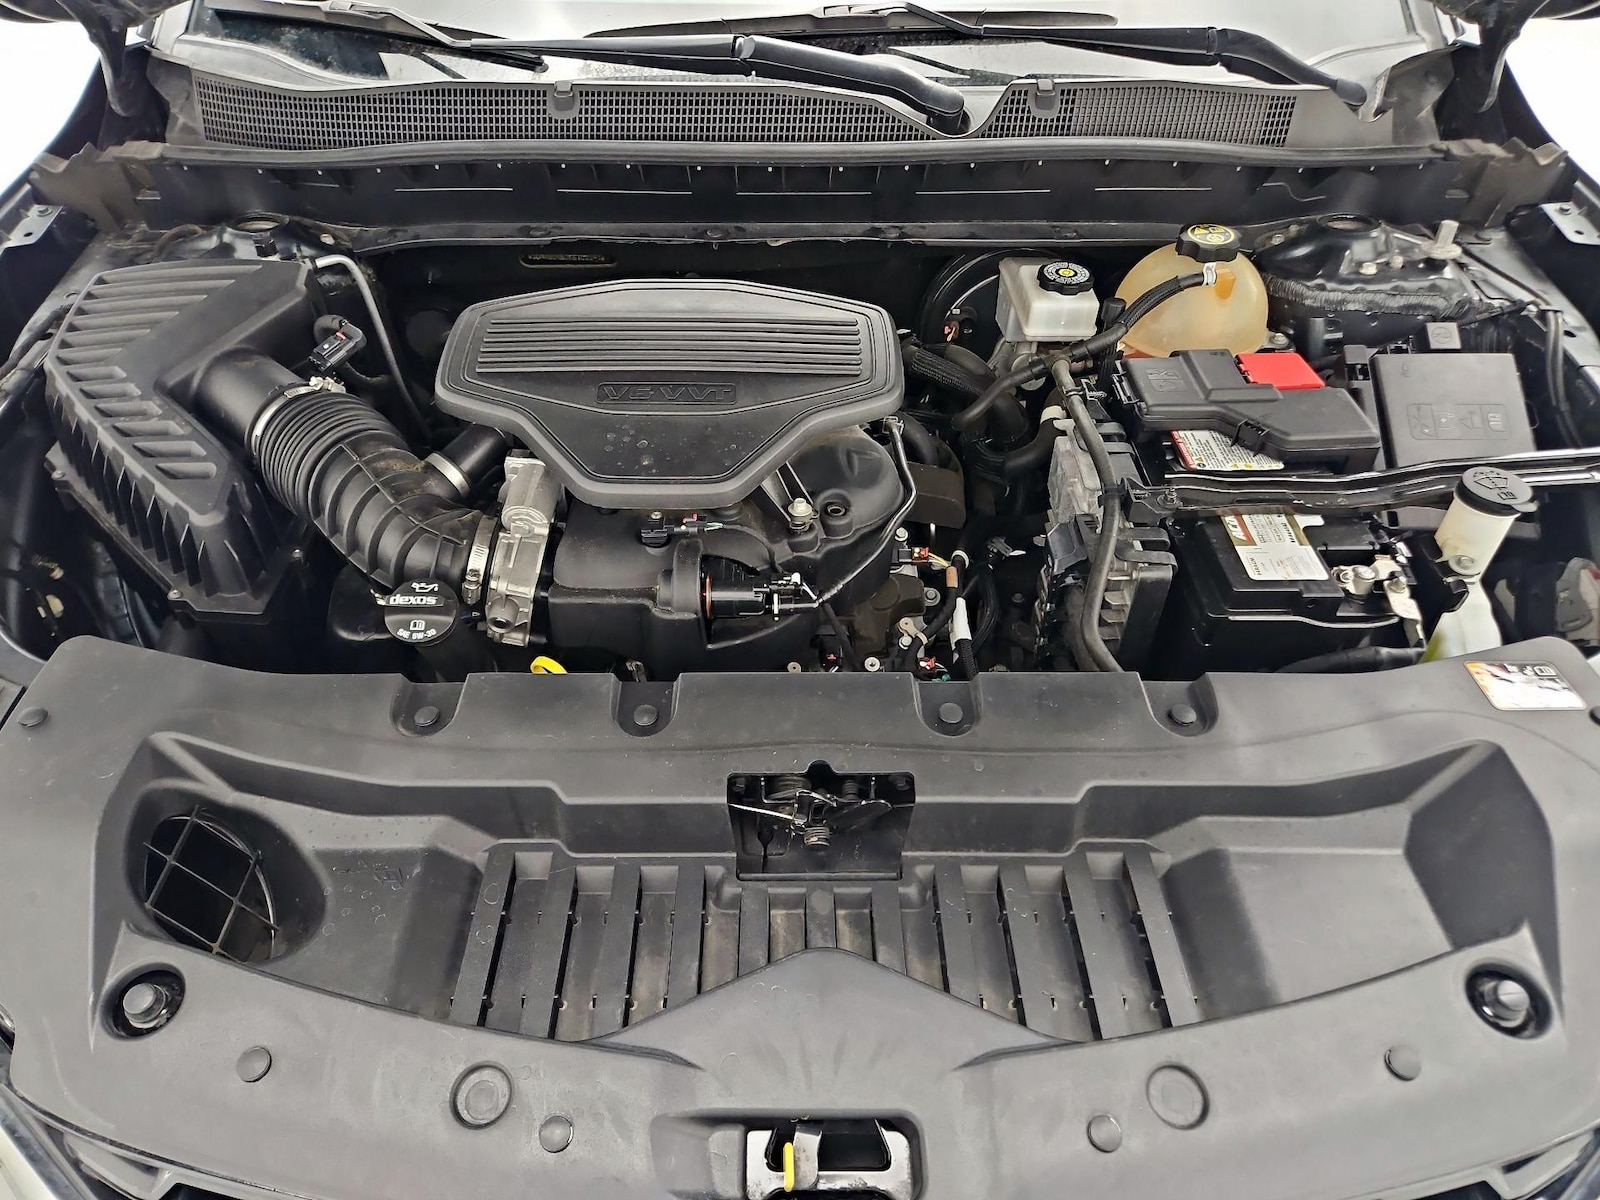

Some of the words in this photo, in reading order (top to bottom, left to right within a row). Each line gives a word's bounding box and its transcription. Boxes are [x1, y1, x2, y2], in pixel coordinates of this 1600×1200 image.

[659, 386, 732, 400] VVT
[389, 593, 438, 605] dexos
[396, 628, 411, 639] SAE
